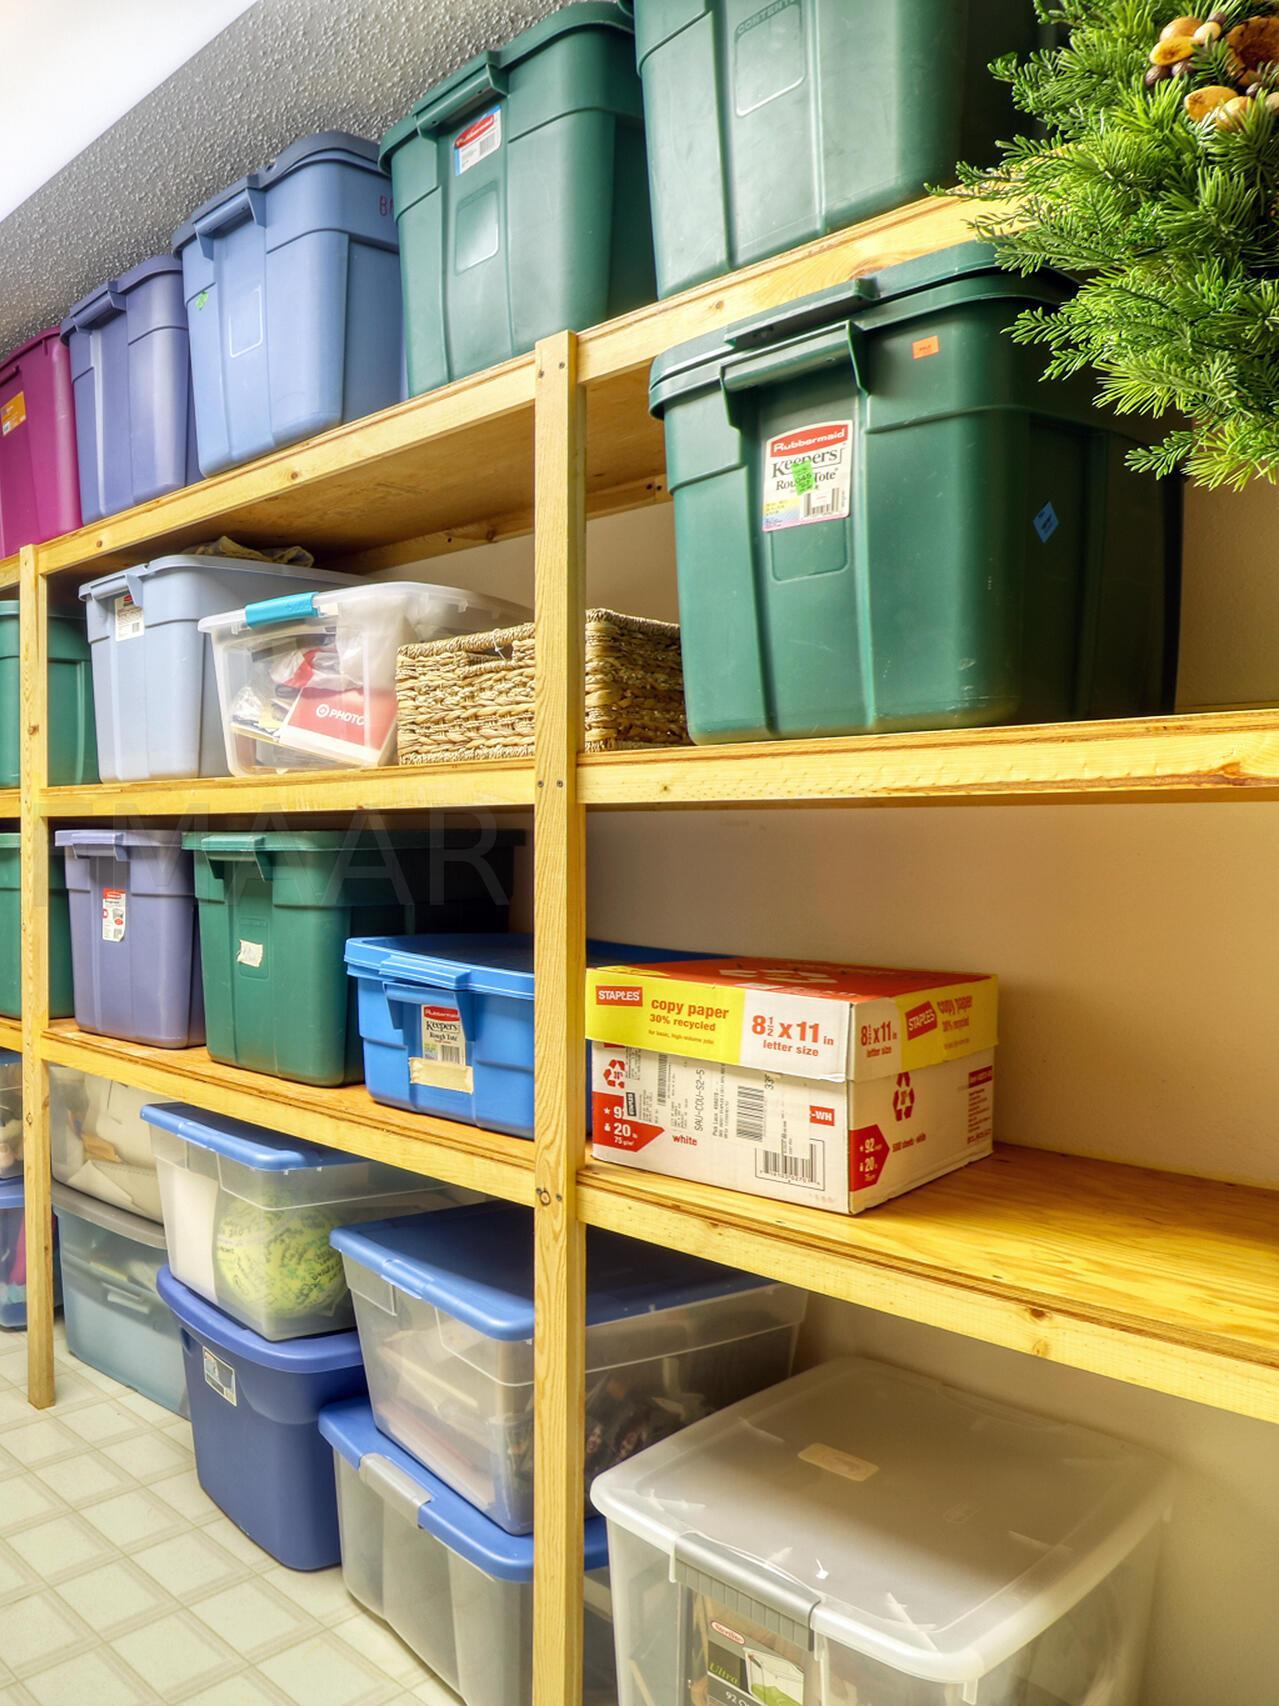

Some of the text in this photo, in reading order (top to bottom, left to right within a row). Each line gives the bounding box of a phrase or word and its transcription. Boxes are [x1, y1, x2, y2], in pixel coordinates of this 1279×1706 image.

[773, 428, 845, 453] Rubbermaid
[598, 991, 640, 1001] STAPLES
[651, 1000, 729, 1019] copy paper
[426, 1020, 457, 1033] Keepers
[649, 1013, 716, 1031] 30% recycled
[908, 1008, 936, 1032] STAPLES
[823, 1036, 834, 1045] in
[763, 1040, 819, 1057] letter size
[613, 1106, 624, 1119] 9
[613, 1122, 631, 1136] 20
[672, 1134, 698, 1146] white
[709, 1661, 739, 1685] Ultra
[725, 1691, 737, 1703] 92
